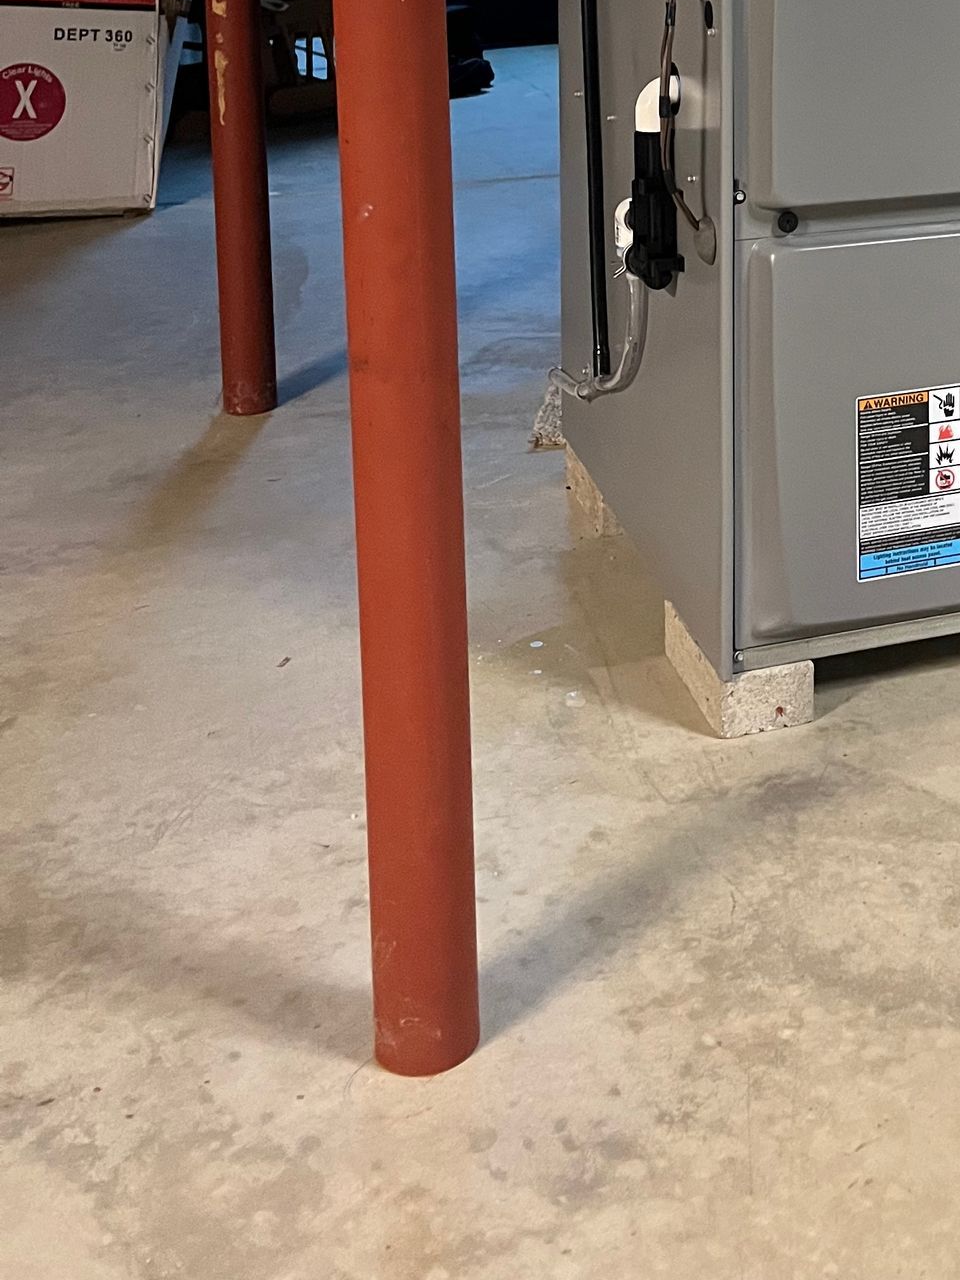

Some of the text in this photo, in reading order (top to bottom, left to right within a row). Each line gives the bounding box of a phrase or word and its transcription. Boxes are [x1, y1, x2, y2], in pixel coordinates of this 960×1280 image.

[54, 27, 133, 43] DEPT 360
[2, 66, 53, 83] Clear Lights
[12, 80, 38, 119] X
[874, 393, 924, 408] WARNING
